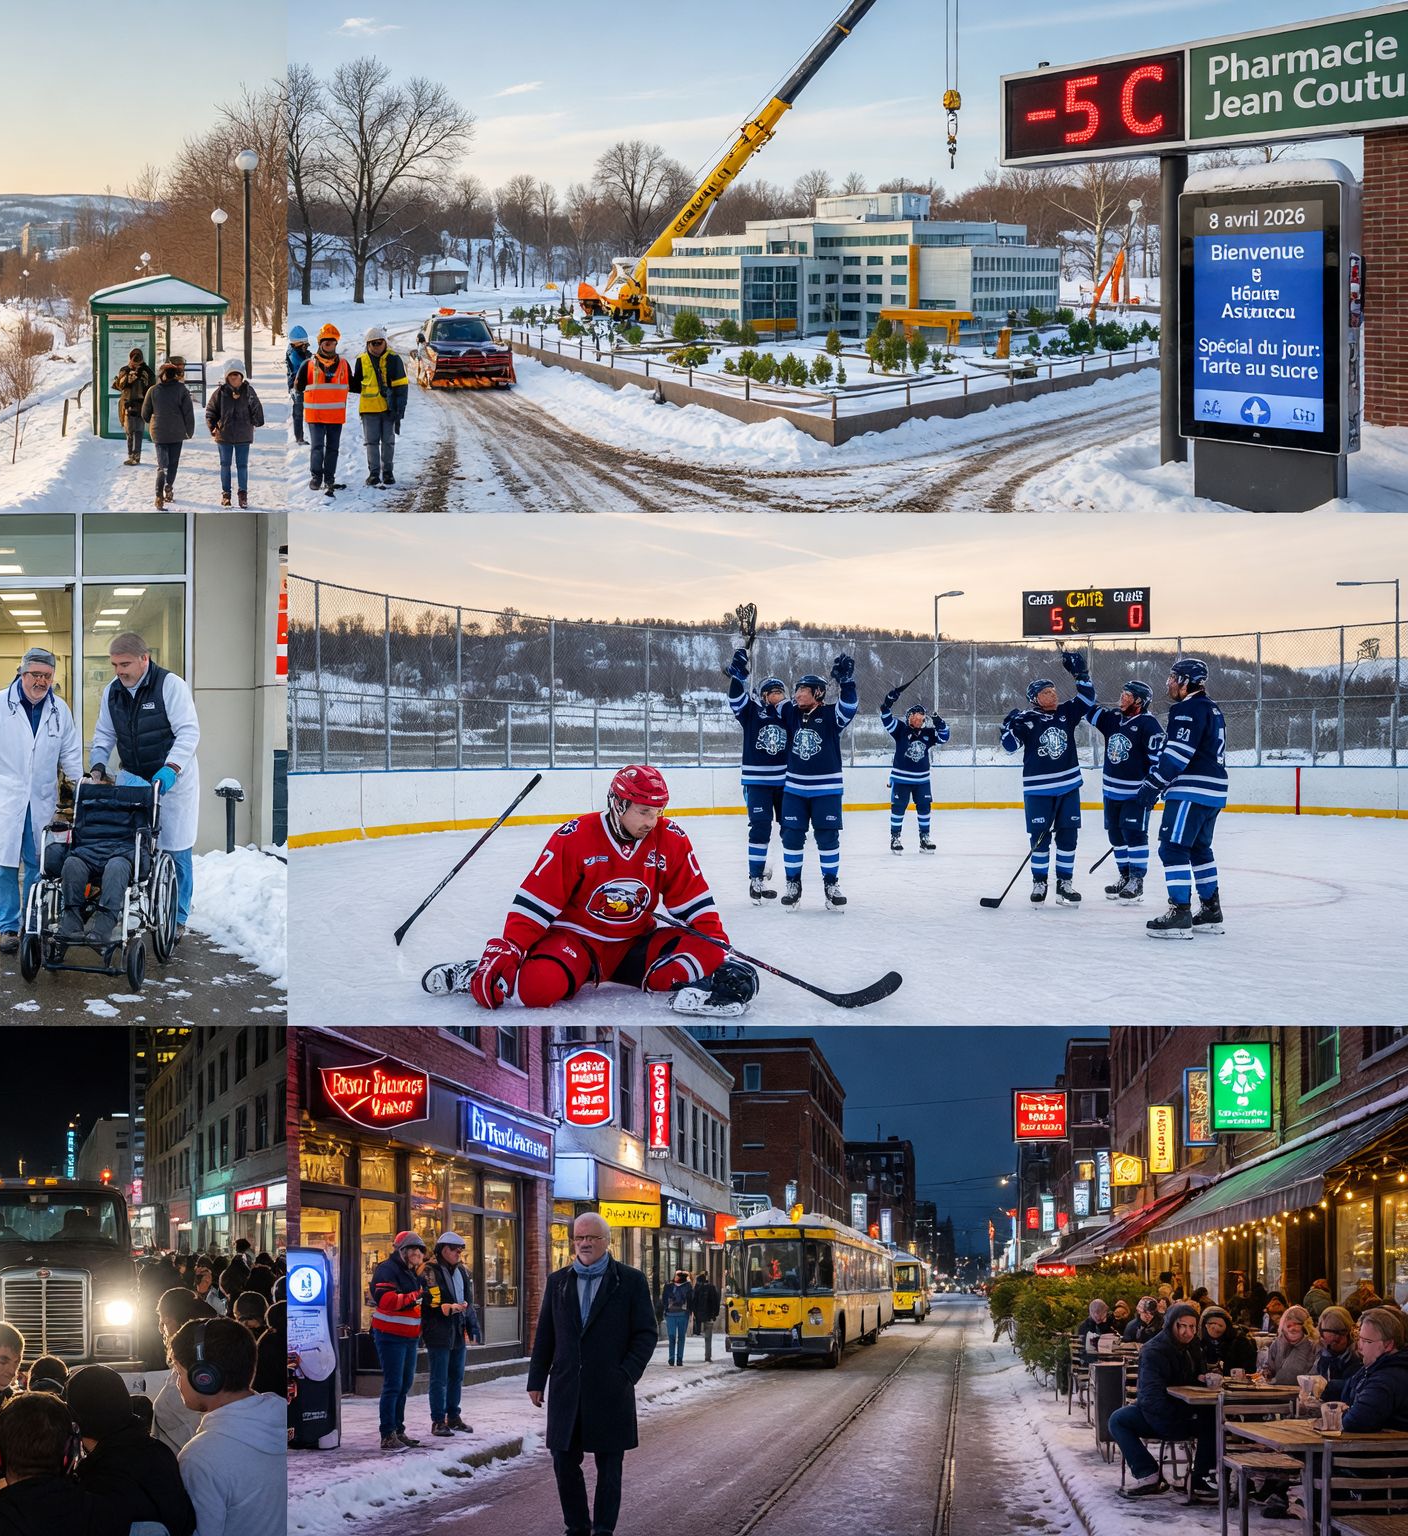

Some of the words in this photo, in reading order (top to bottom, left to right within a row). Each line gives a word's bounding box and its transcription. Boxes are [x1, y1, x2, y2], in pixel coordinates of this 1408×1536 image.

[1208, 29, 1398, 86] Pharmacie
[1122, 65, 1164, 134] C
[1204, 90, 1283, 121] Jean
[1293, 71, 1406, 109] Coutu
[1209, 213, 1219, 229] 8
[1224, 210, 1259, 228] avril
[1263, 207, 1306, 226] 2026
[1211, 244, 1305, 261] Bienvenue
[1257, 340, 1278, 355] du
[1281, 339, 1320, 360] jour:
[1198, 356, 1241, 375] Tarte
[1245, 362, 1266, 376] au
[1270, 364, 1319, 380] sucre
[1051, 607, 1064, 631] 5
[1129, 604, 1143, 628] 0
